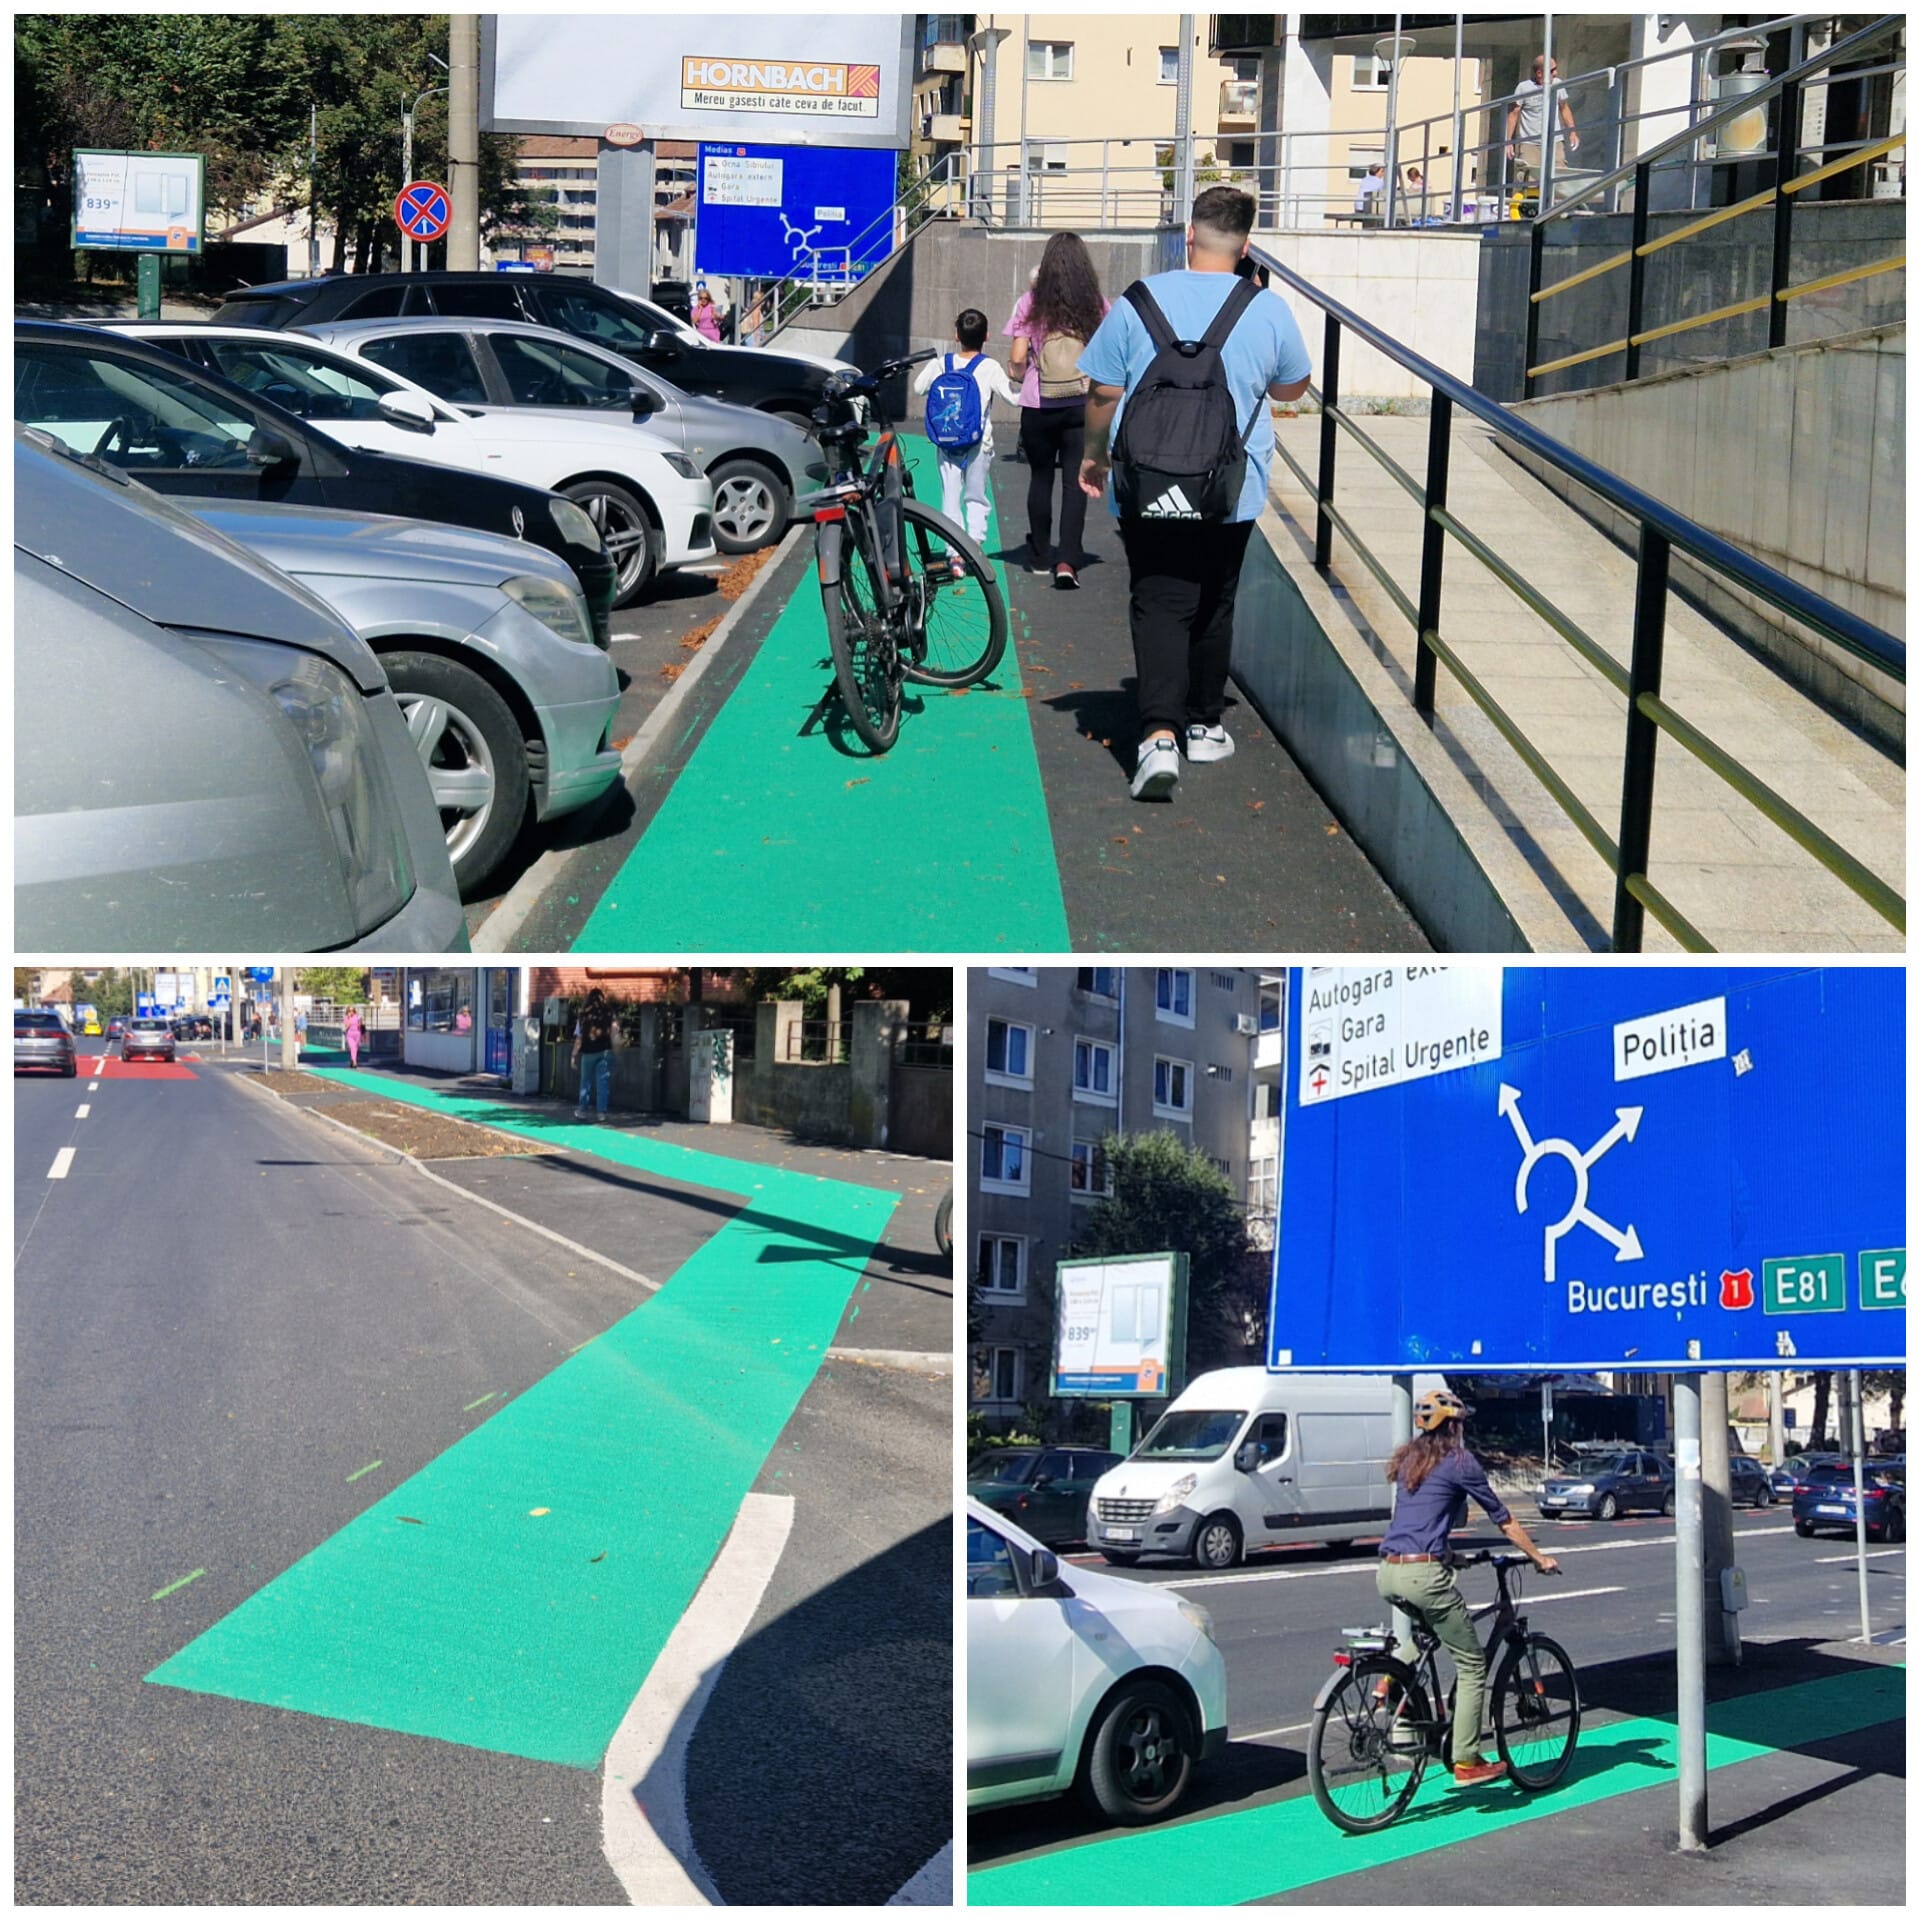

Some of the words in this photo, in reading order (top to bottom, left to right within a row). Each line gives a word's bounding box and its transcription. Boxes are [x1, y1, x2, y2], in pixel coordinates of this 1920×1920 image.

[687, 61, 844, 92] HORNBACH
[694, 92, 725, 105] Mereu
[795, 99, 817, 110] ceva
[821, 98, 833, 110] de
[609, 129, 641, 139] Energy
[86, 198, 111, 209] 839
[1309, 969, 1393, 1014] Autogara
[1341, 1013, 1385, 1043] Gara
[1623, 1018, 1715, 1067] Poliția
[1341, 1048, 1396, 1089] Spital
[1567, 1271, 1707, 1322] București
[1730, 1279, 1740, 1300] 1
[1775, 1267, 1828, 1304] E81
[1067, 1325, 1090, 1341] 839
